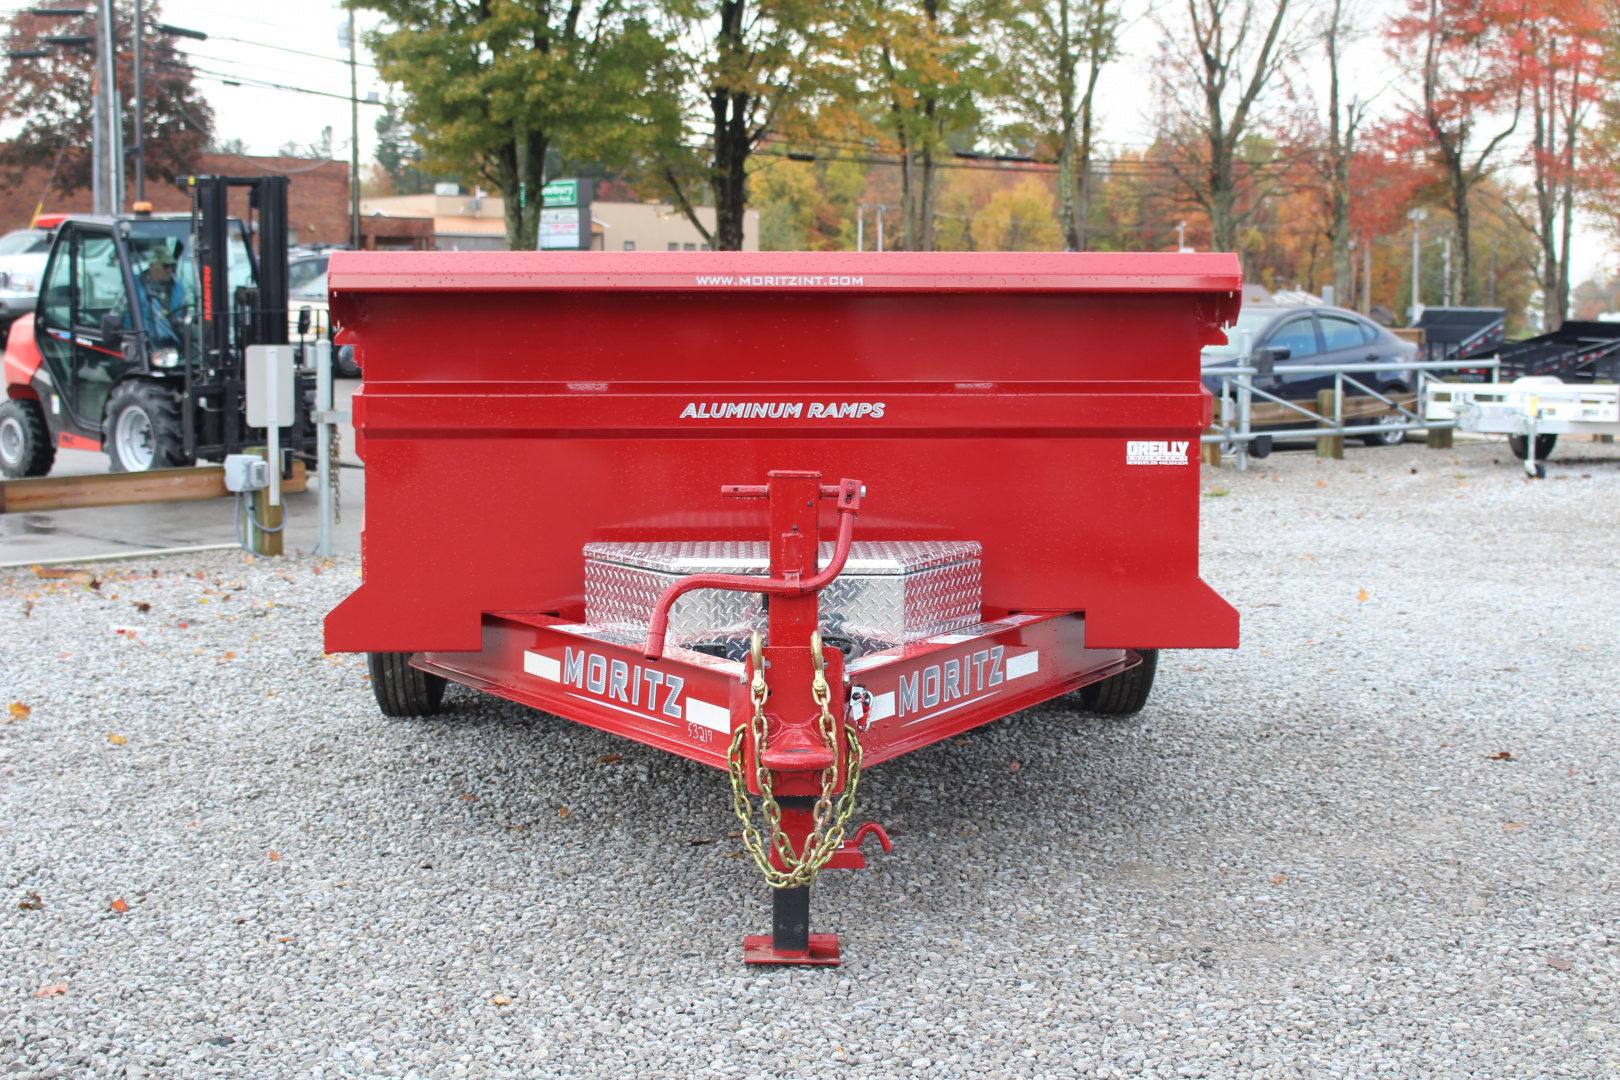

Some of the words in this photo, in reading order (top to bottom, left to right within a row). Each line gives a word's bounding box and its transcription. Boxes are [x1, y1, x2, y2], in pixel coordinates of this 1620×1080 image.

[696, 276, 864, 286] WWW.MORITZINT.COM
[680, 402, 804, 419] ALUMINUM
[807, 402, 886, 419] RAMPS
[563, 646, 684, 719] MORITZ
[899, 644, 1005, 718] MORITZ
